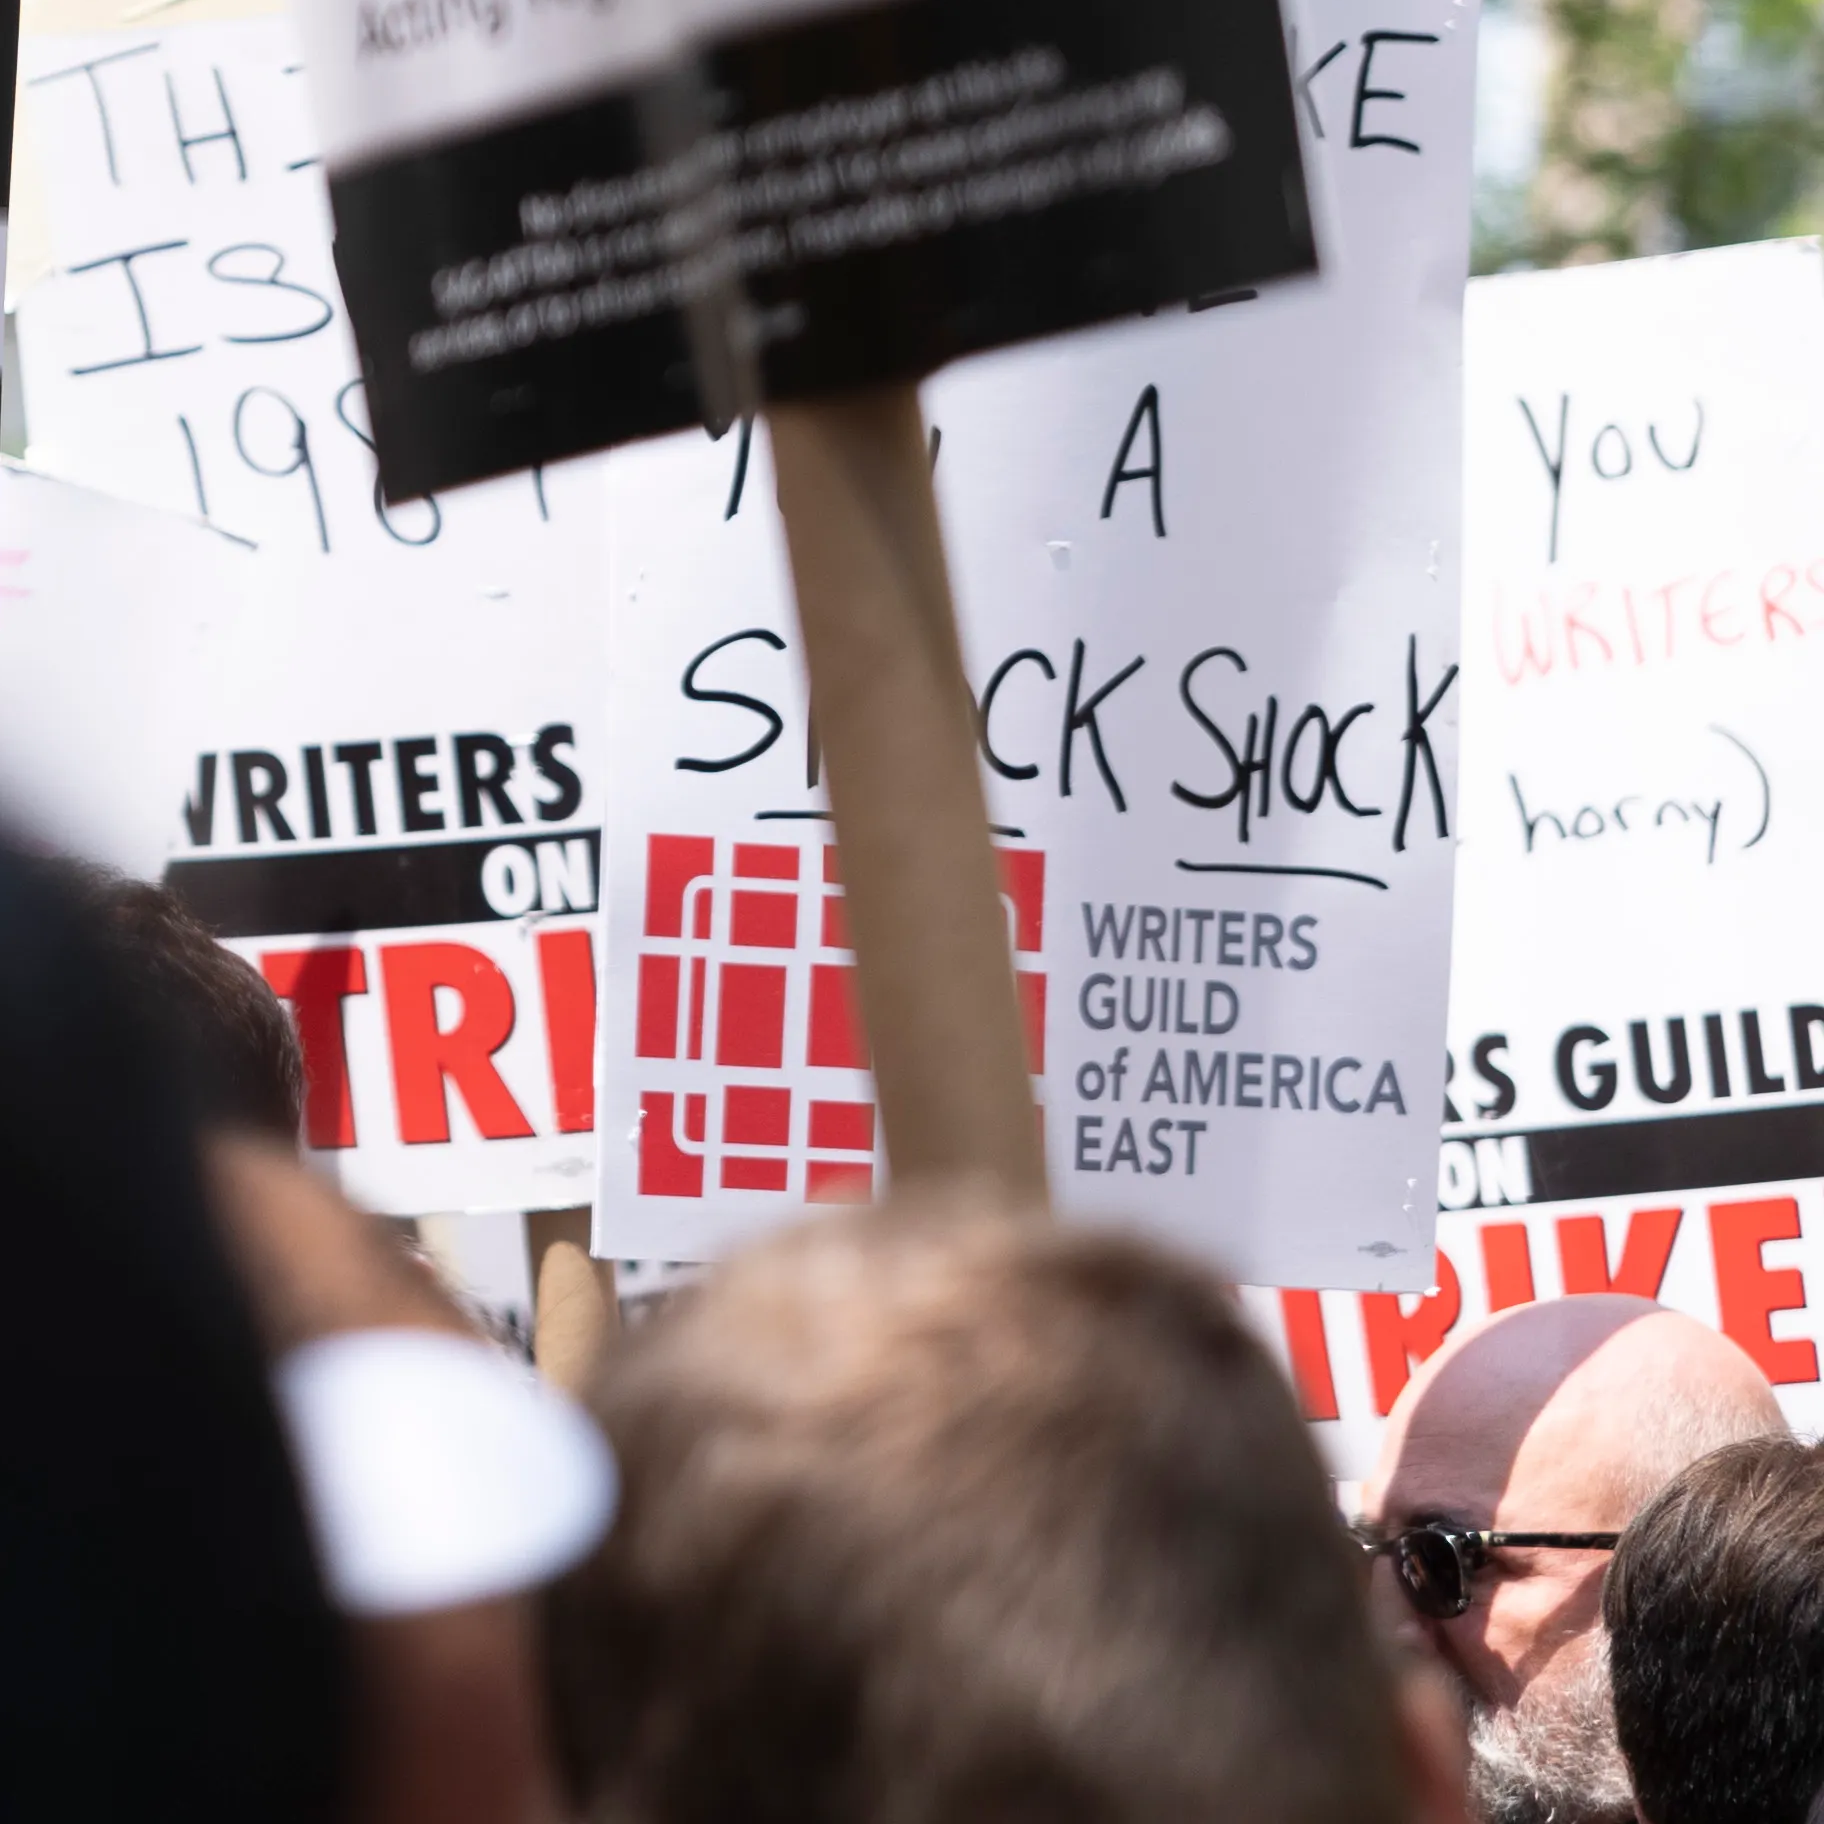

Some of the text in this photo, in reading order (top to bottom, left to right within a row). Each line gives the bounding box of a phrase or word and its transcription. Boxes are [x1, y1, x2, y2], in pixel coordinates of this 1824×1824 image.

[28, 42, 320, 186] TH
[67, 240, 333, 376] IS
[177, 378, 550, 555] 198
[1100, 384, 1166, 538] A
[677, 628, 1144, 811] SCK
[482, 838, 596, 918] ON
[1081, 901, 1319, 972] WRITERS
[1078, 974, 1240, 1035] GUILD
[1075, 1047, 1132, 1106] of
[1142, 1051, 1408, 1117] AMERICA
[1557, 1003, 1824, 1112] GUILD
[1074, 1115, 1208, 1176] EAST
[1439, 1136, 1533, 1210] ON
